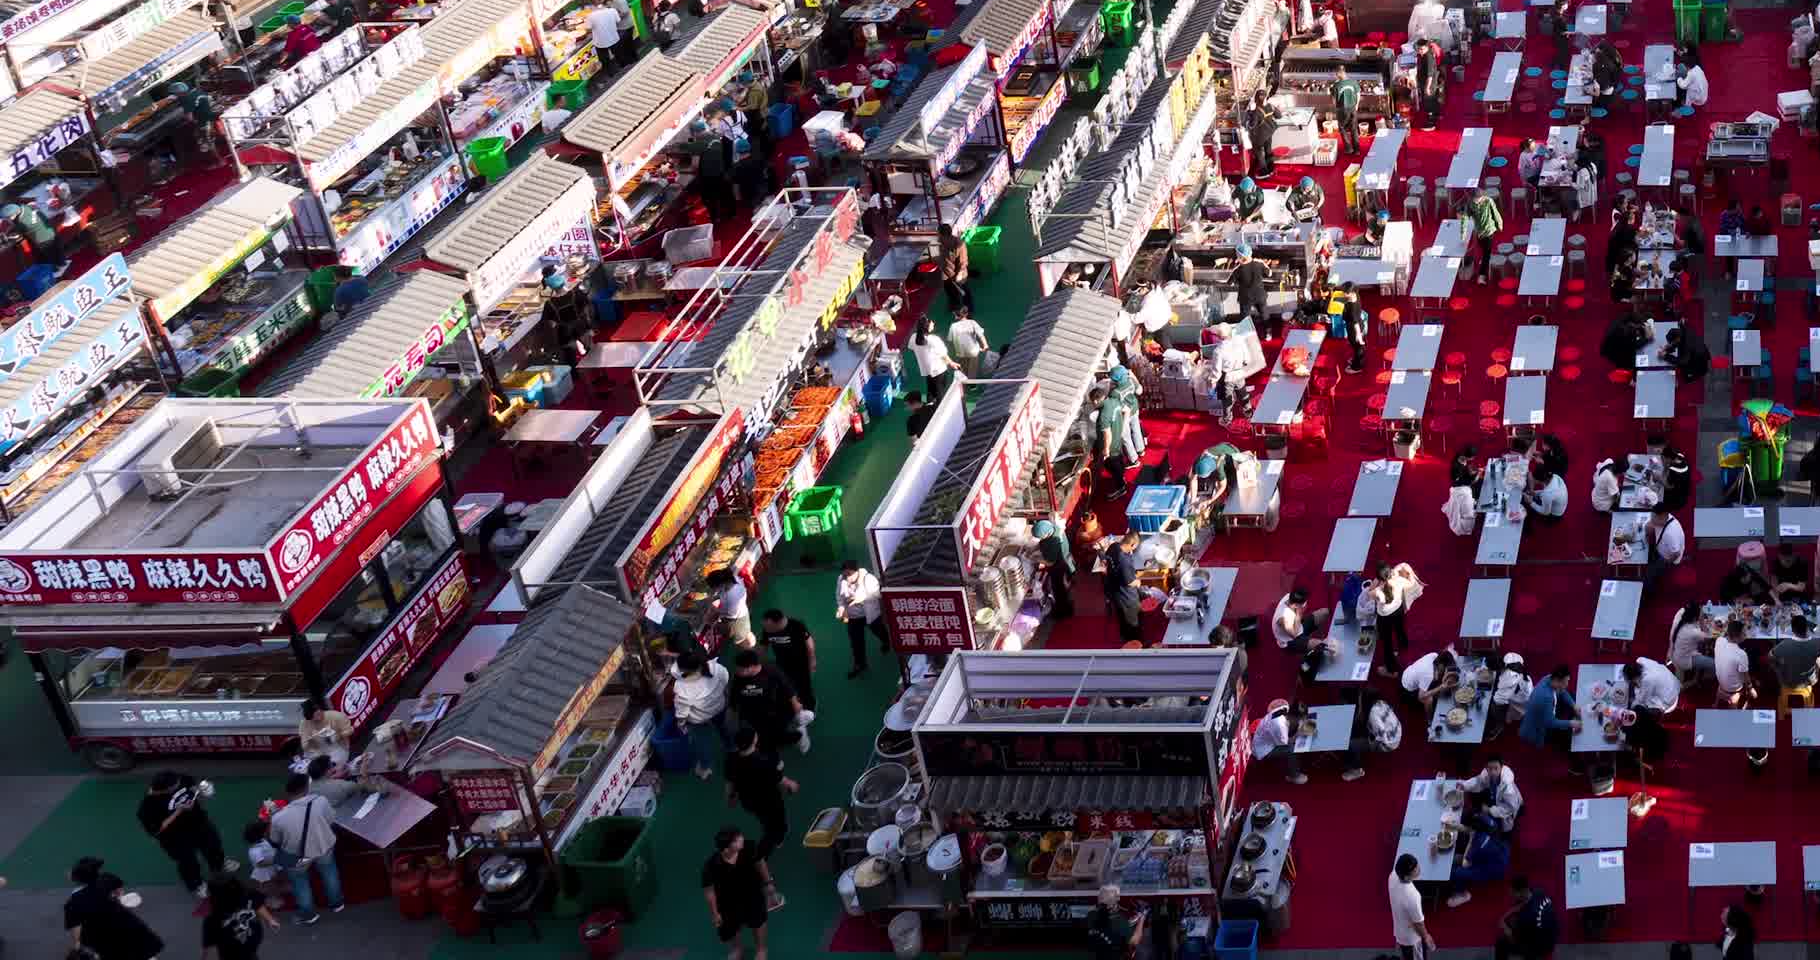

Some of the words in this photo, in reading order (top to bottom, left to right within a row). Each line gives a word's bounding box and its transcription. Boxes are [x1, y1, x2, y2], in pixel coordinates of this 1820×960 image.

[8, 114, 85, 178] 五花肉
[366, 409, 430, 490] 麻辣久久鸭
[310, 472, 368, 544] 甜辣黑鸭
[32, 558, 136, 590] 甜辣黑鸭
[142, 557, 268, 592] 麻辣久久鸭
[891, 598, 956, 613] 朝鲜冷面
[896, 615, 961, 630] 烧麦馄饨
[900, 633, 964, 647] 灌汤包
